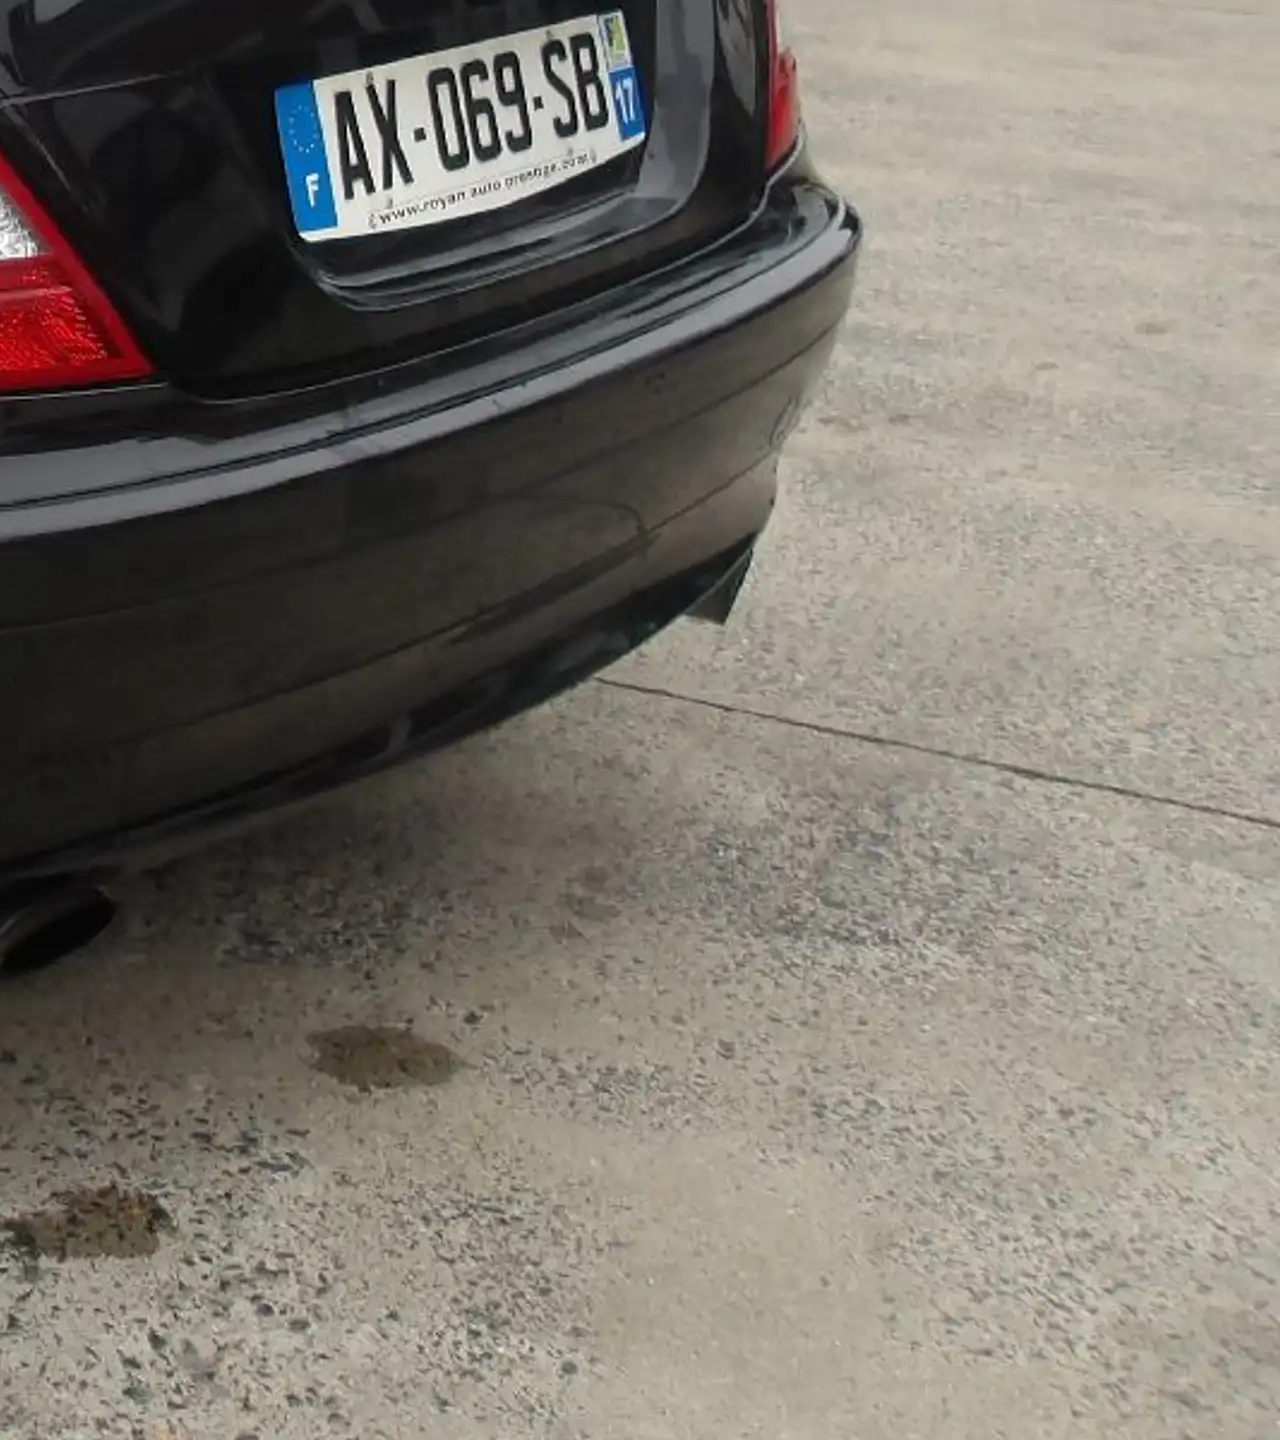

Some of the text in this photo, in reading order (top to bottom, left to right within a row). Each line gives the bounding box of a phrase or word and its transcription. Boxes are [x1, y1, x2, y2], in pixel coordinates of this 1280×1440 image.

[333, 33, 610, 200] AX-069-SB
[615, 77, 636, 125] 17
[304, 172, 319, 208] F
[378, 190, 466, 224] www.royan
[471, 177, 502, 198] auto
